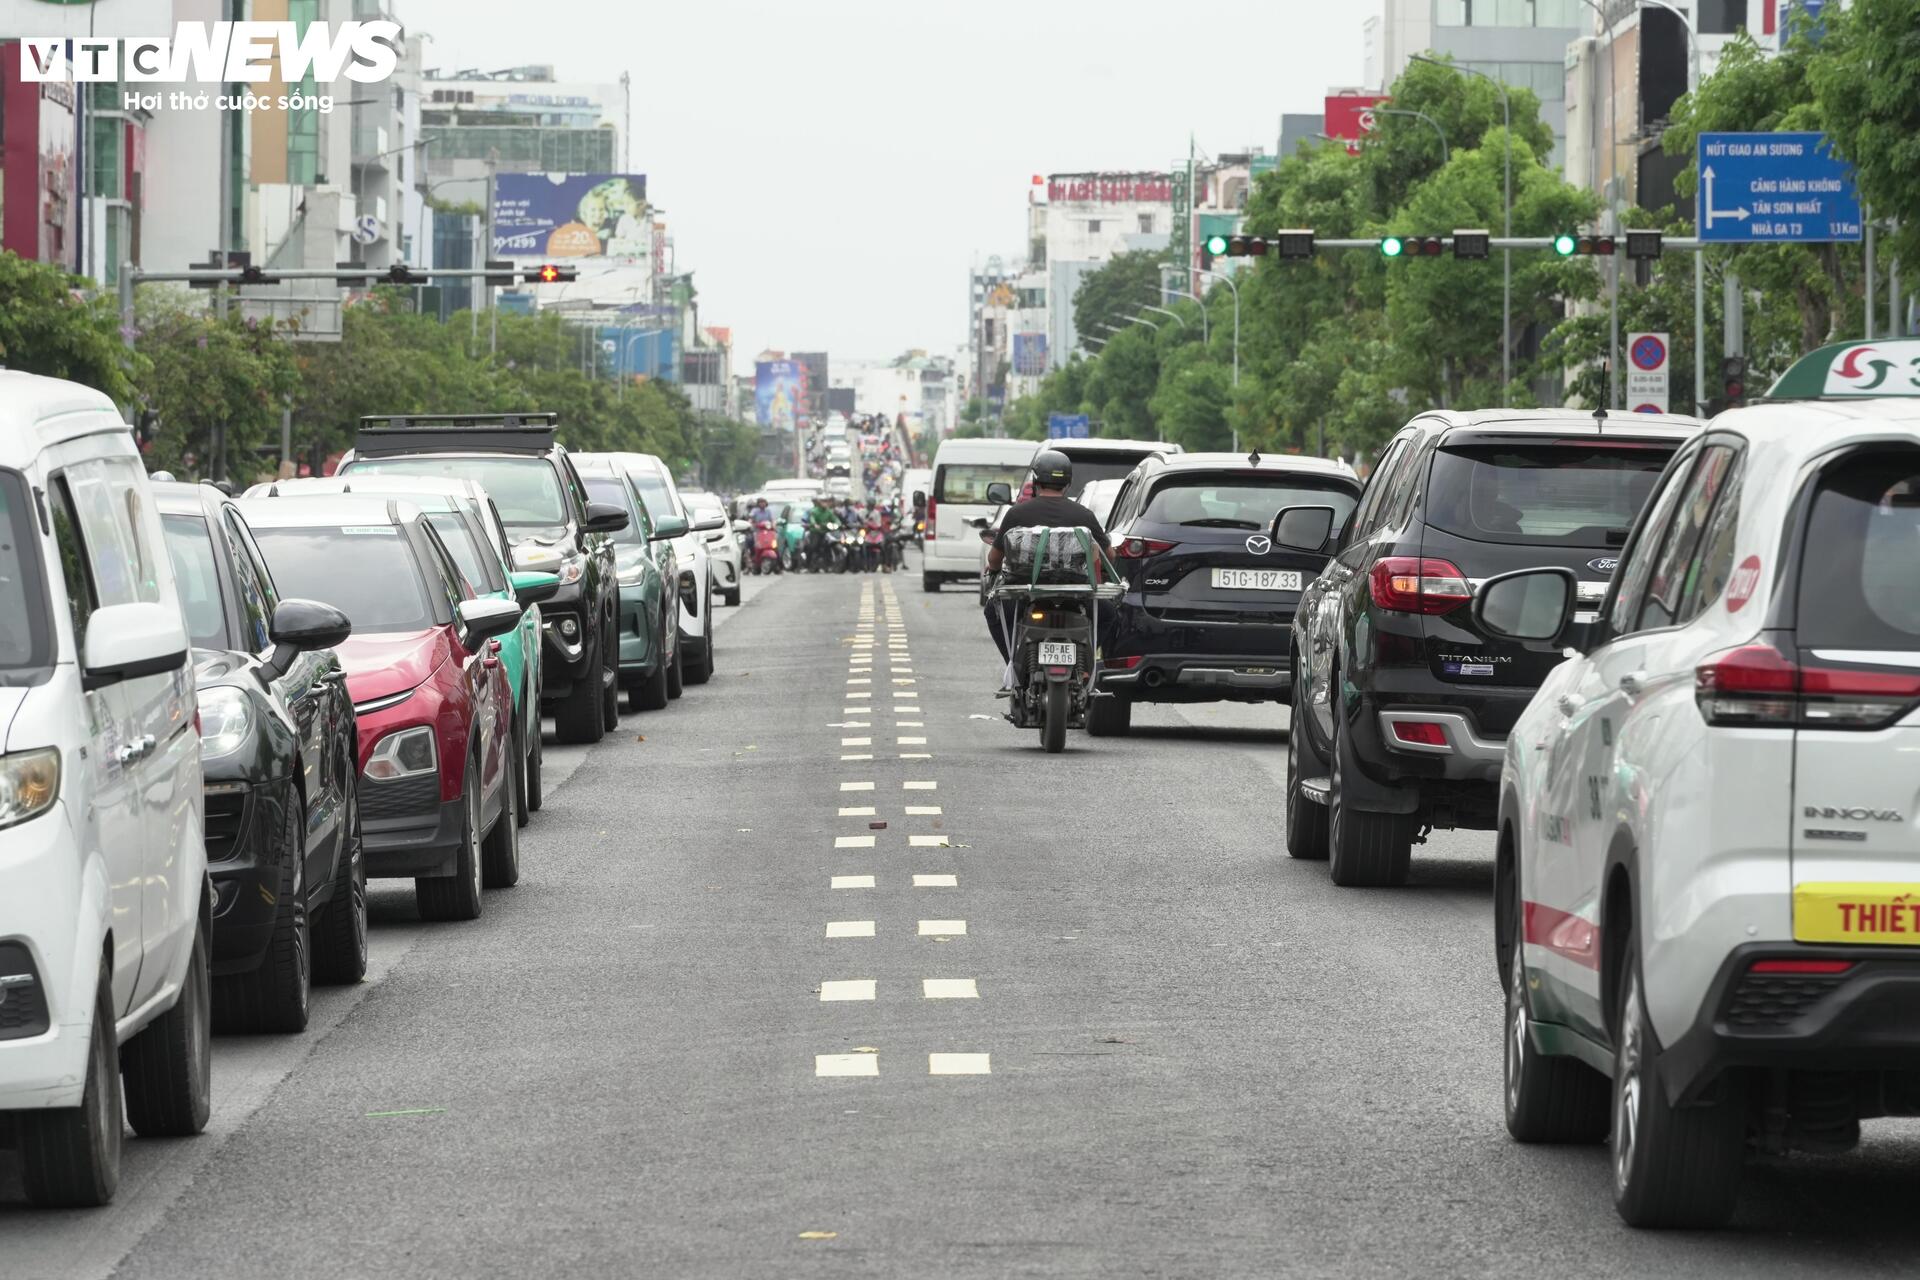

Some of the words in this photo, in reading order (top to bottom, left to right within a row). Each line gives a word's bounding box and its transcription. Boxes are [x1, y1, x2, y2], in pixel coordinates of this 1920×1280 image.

[1706, 140, 1726, 156] NÚT
[1728, 143, 1751, 156] GIAO
[1752, 143, 1768, 156] AN
[1779, 176, 1806, 192] HÀNG
[1807, 176, 1841, 192] KHÔNG
[1752, 200, 1772, 214] TÂN
[1795, 198, 1823, 214] NHẤT
[1752, 220, 1773, 235] NHÀ
[1774, 223, 1788, 235] GA
[1790, 223, 1803, 235] T3
[1222, 570, 1298, 588] 51G-187.33
[1044, 644, 1070, 654] 50-AE
[1042, 654, 1073, 664] 179.06
[1438, 654, 1512, 664] TITANIUM
[1803, 806, 1904, 822] INNOVA
